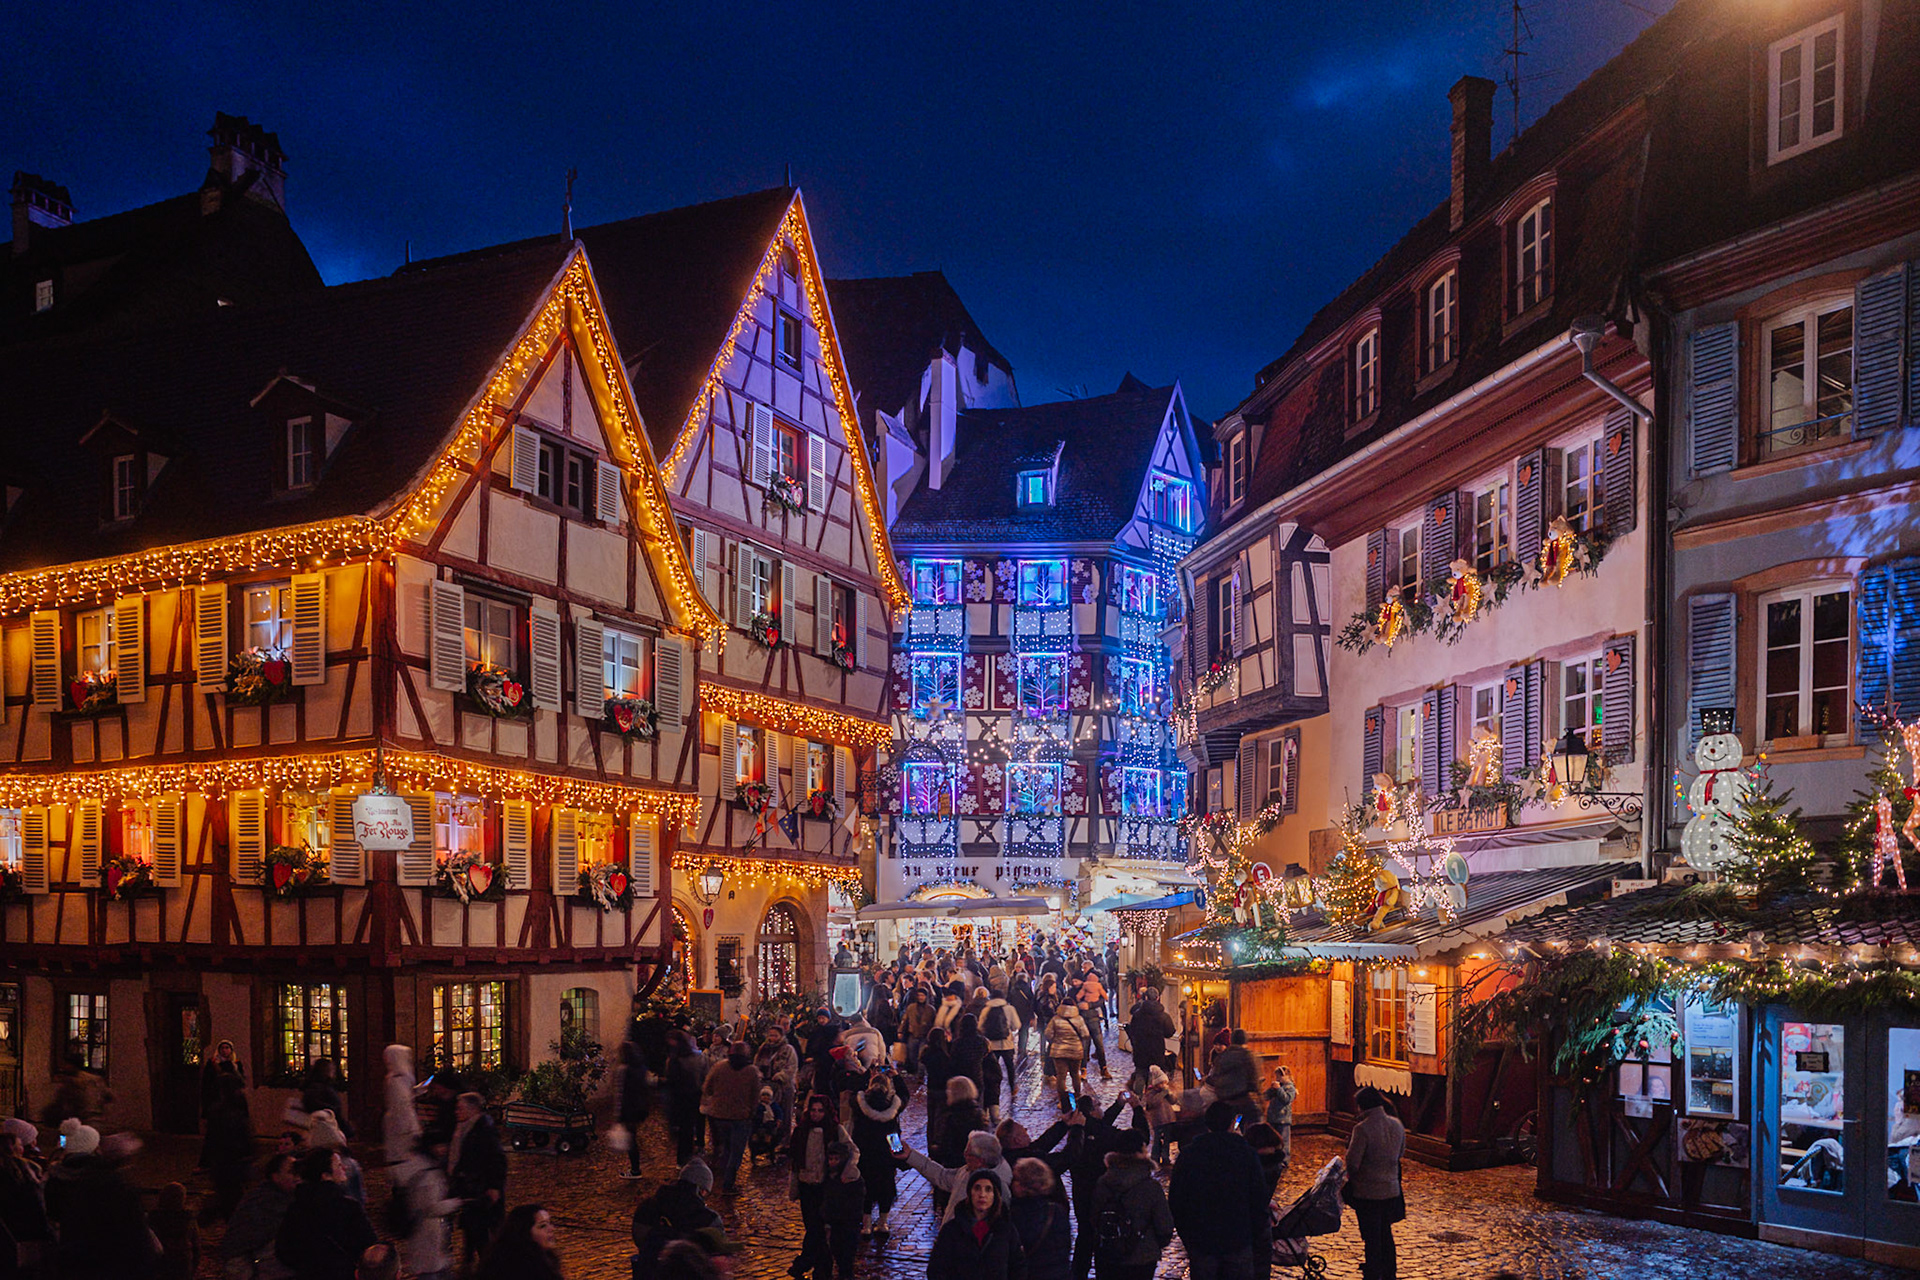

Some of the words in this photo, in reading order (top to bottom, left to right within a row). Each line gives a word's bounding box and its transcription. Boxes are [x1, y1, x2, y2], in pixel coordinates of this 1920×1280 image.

[1440, 813, 1453, 833] LE
[1457, 805, 1500, 831] BISTROT
[356, 820, 378, 838] Fer
[376, 820, 409, 840] Rouge
[935, 862, 979, 877] vieux
[995, 861, 1052, 881] pignon
